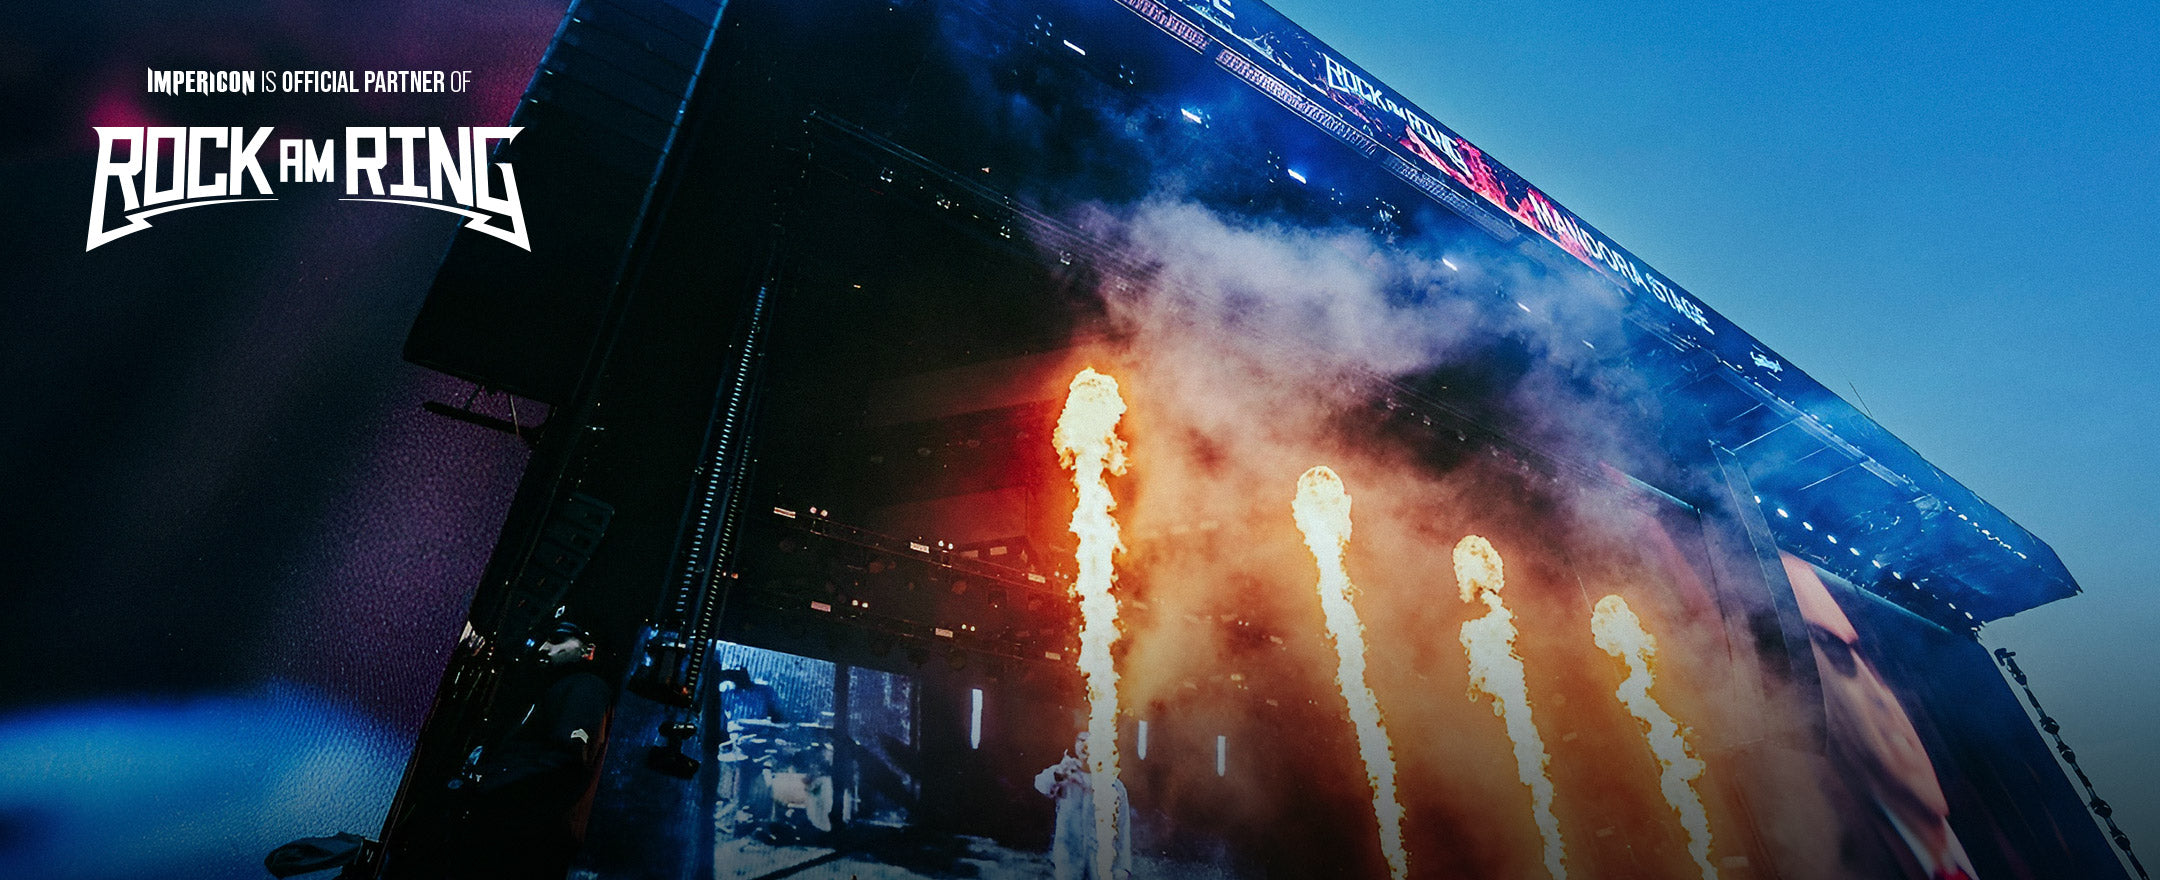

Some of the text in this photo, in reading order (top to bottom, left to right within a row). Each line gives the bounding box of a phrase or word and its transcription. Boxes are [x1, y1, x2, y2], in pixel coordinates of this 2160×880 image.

[1322, 53, 1389, 112] ROCK
[1405, 108, 1472, 176] RING
[1527, 189, 1715, 336] MANDORA STAGE
